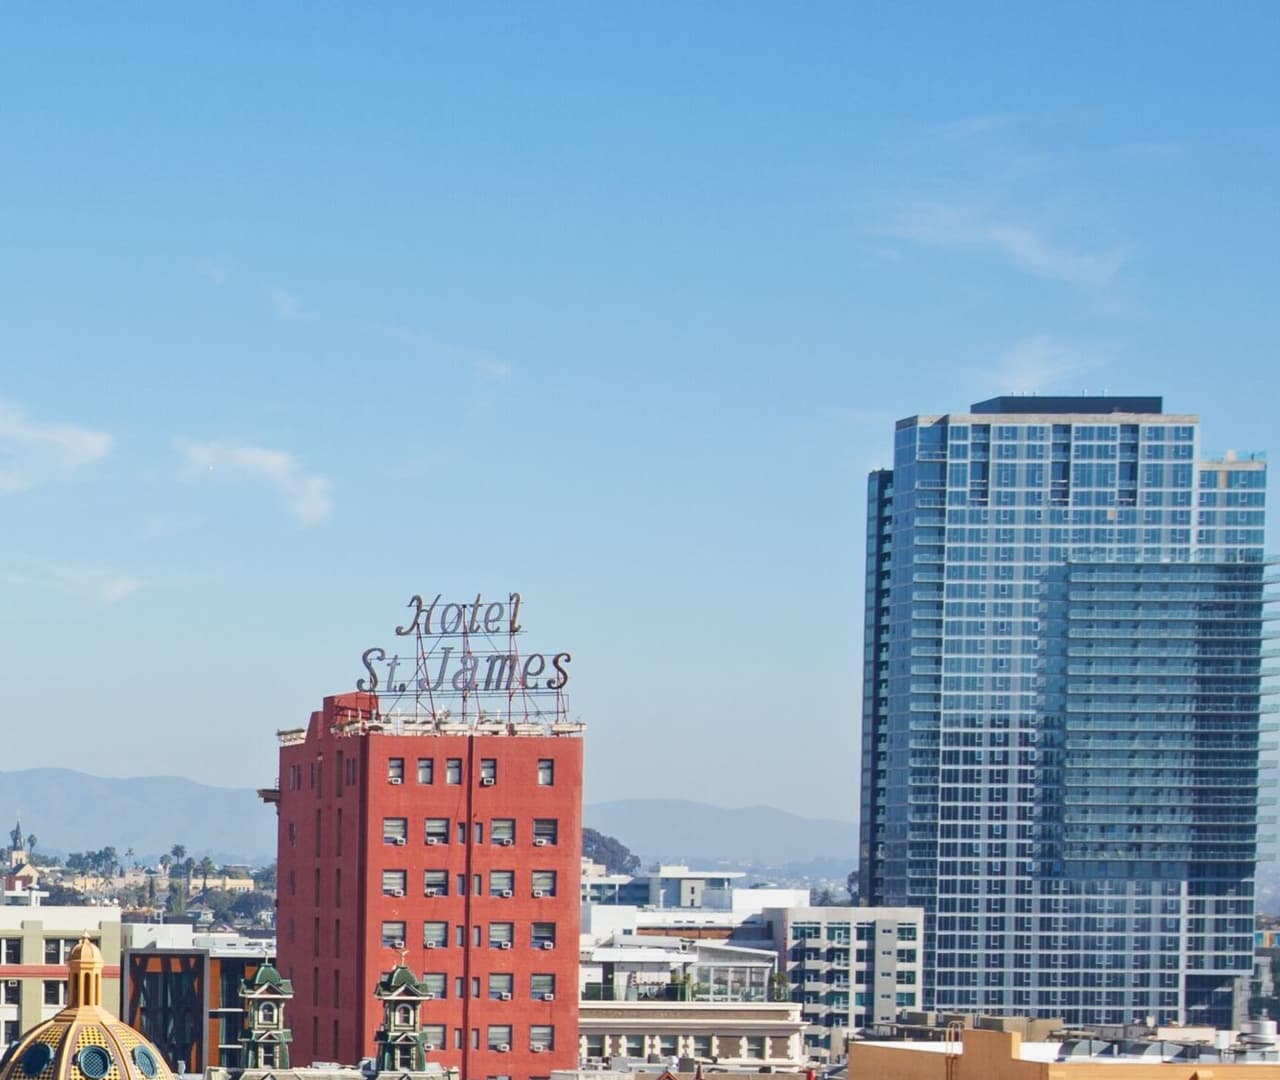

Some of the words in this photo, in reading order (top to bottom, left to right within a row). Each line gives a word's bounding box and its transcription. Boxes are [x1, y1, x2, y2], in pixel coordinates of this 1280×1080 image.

[395, 592, 522, 636] Hotel
[356, 647, 407, 693] St.
[418, 646, 572, 692] James
